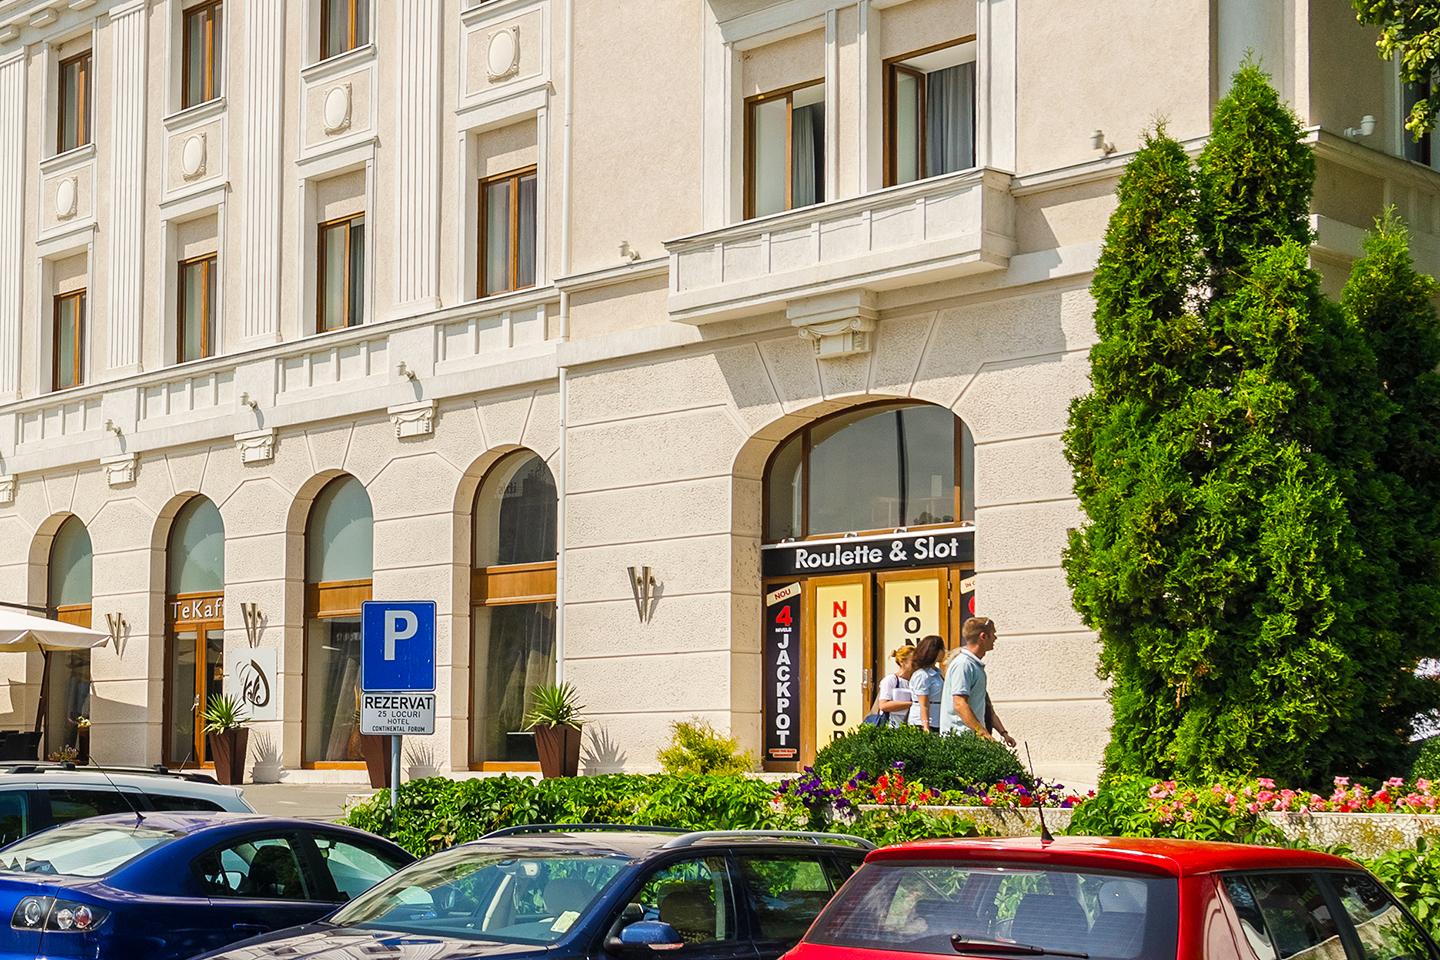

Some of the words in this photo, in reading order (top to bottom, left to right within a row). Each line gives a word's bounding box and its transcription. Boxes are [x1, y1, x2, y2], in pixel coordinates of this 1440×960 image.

[795, 545, 883, 569] Roulette
[889, 541, 908, 561] &
[913, 536, 959, 560] Slot
[774, 588, 791, 600] NOU
[170, 597, 224, 619] TeKaf
[775, 605, 793, 627] 4
[383, 610, 418, 661] P
[832, 601, 847, 659] NON
[776, 634, 791, 746] JACKPOT
[364, 696, 433, 709] REZERVAT
[378, 710, 387, 718] 25
[392, 710, 421, 718] LOCURI
